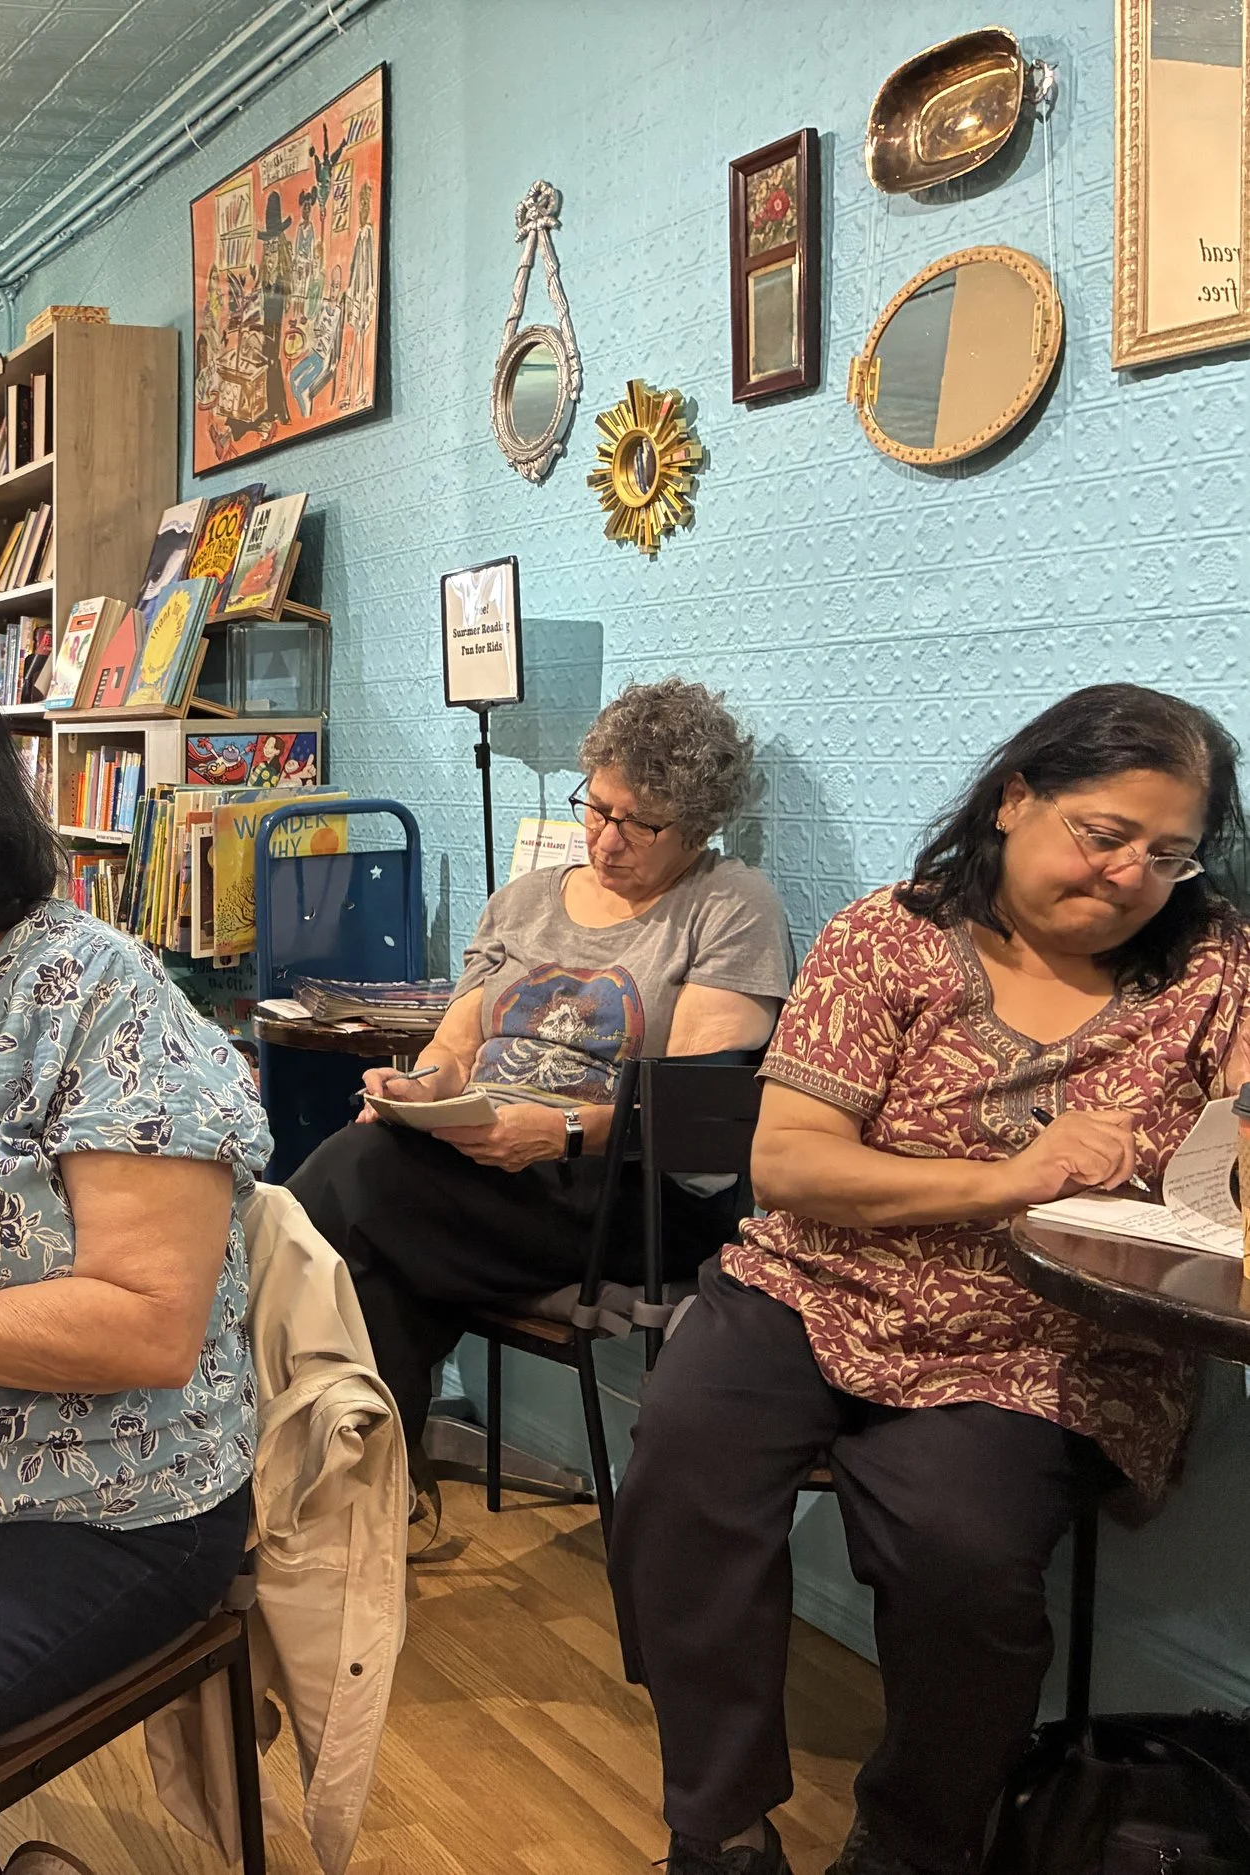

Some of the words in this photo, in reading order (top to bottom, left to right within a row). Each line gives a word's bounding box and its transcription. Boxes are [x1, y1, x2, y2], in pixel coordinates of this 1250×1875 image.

[205, 513, 238, 547] 100
[481, 621, 510, 634] Readig
[461, 645, 474, 656] Fun
[475, 643, 486, 654] for
[487, 641, 503, 652] Kids
[234, 814, 329, 840] WNDER
